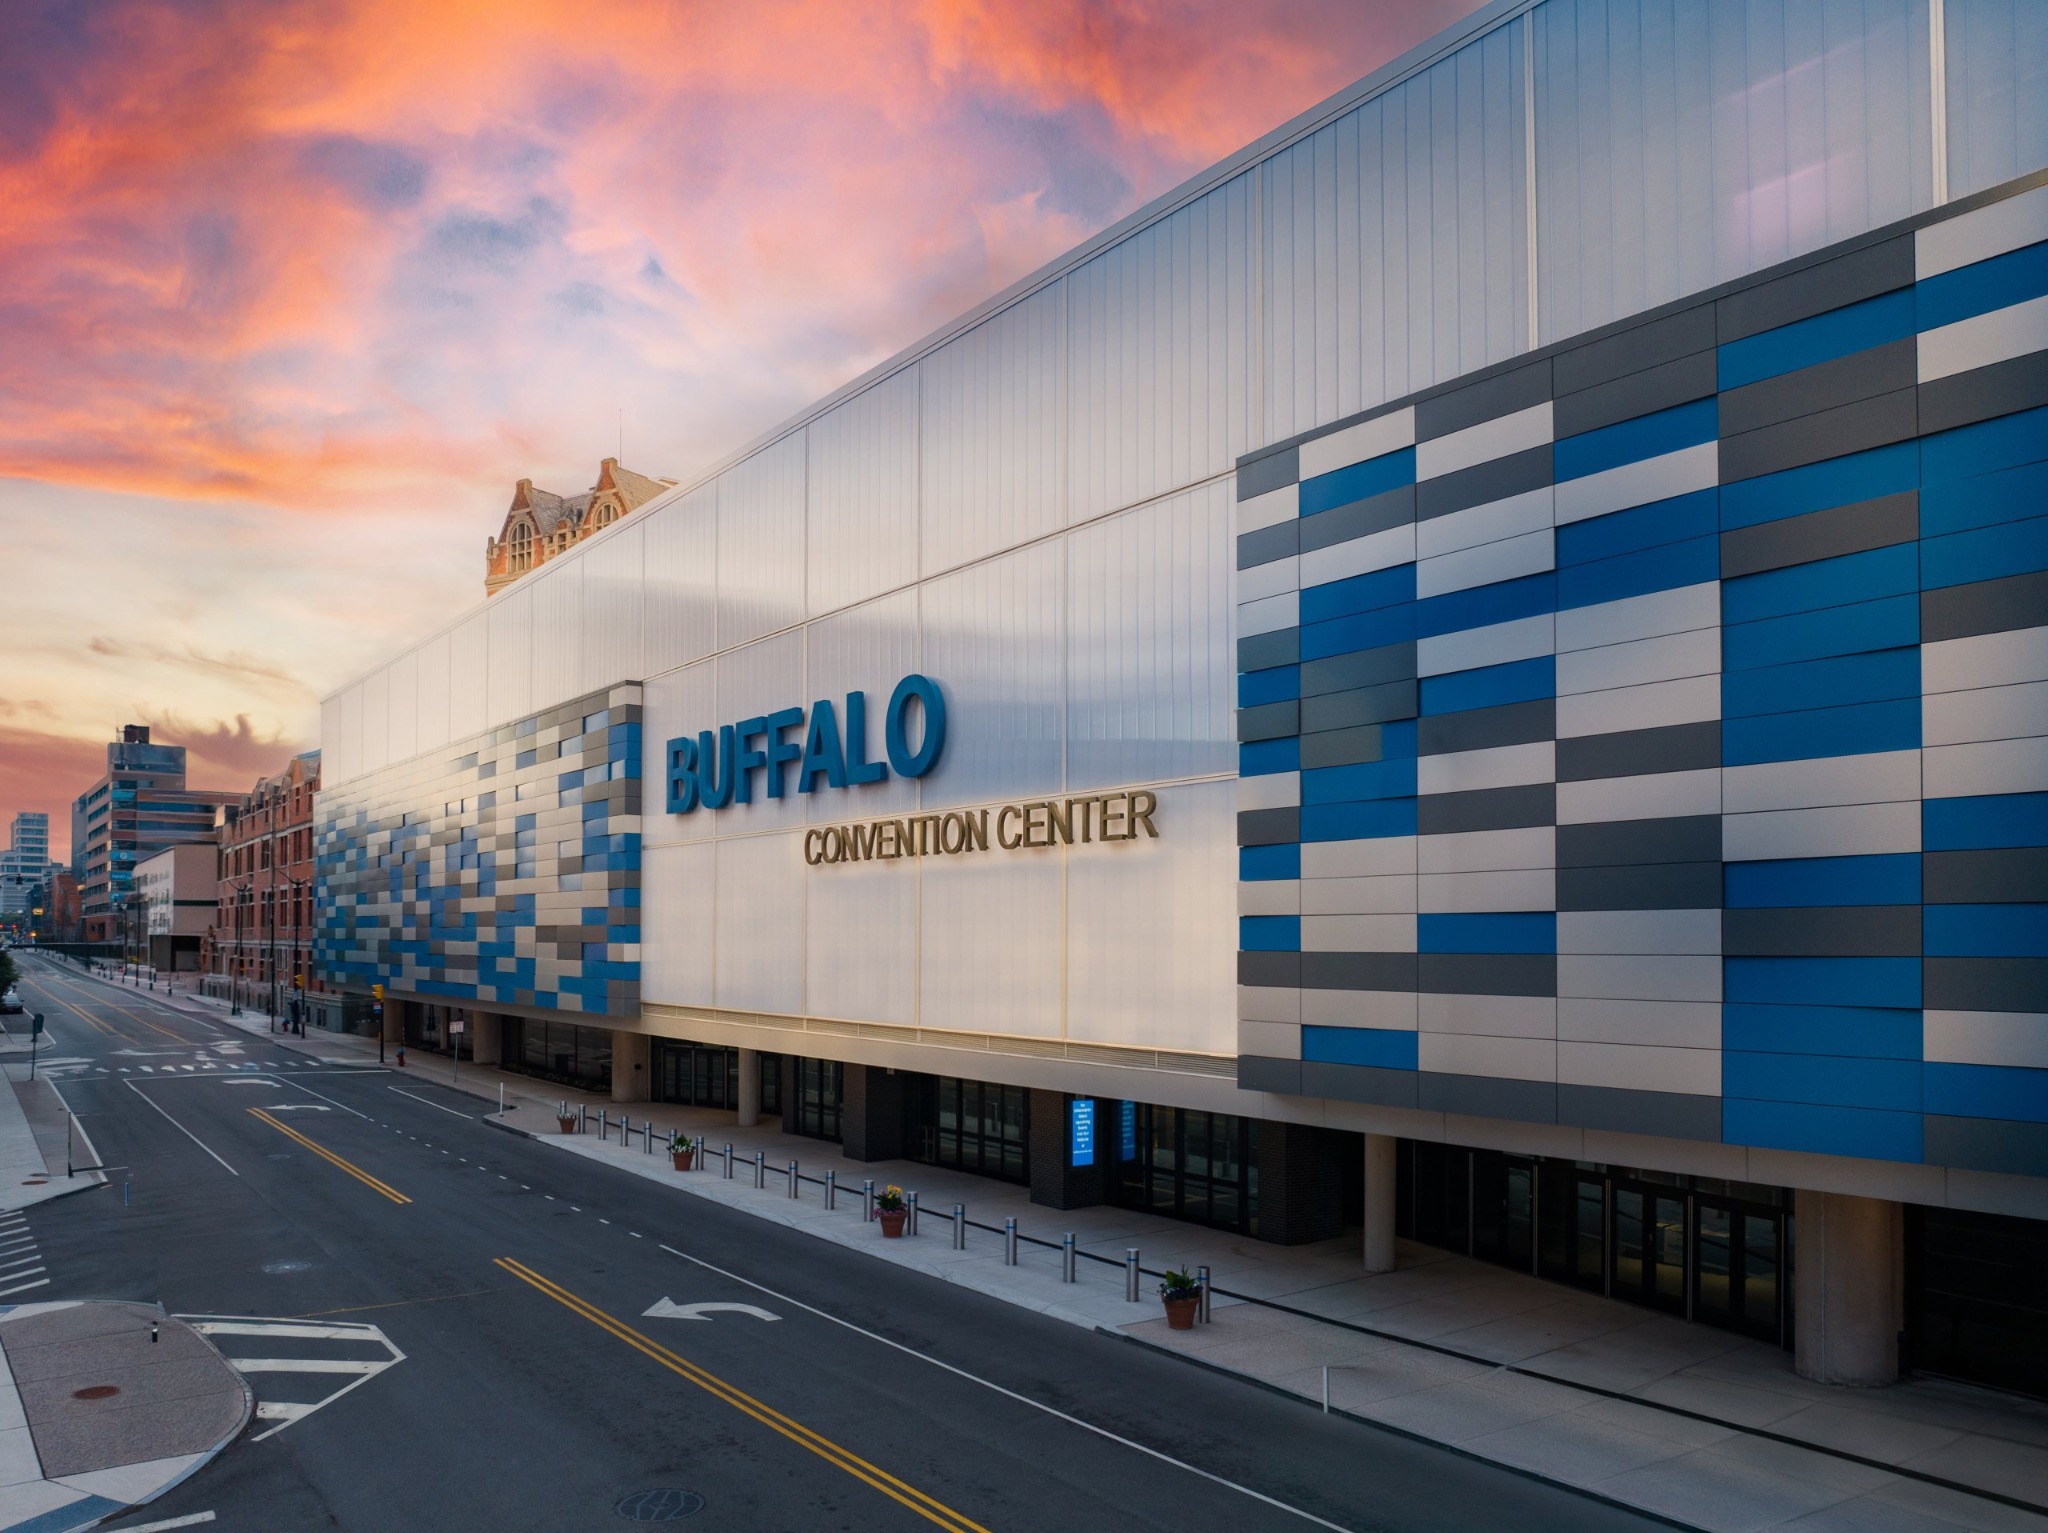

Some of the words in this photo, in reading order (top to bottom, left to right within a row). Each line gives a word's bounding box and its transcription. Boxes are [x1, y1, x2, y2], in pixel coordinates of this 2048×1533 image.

[666, 673, 946, 815] BUFFALO
[804, 809, 990, 866] CONVENTION
[998, 790, 1159, 850] CENTER
